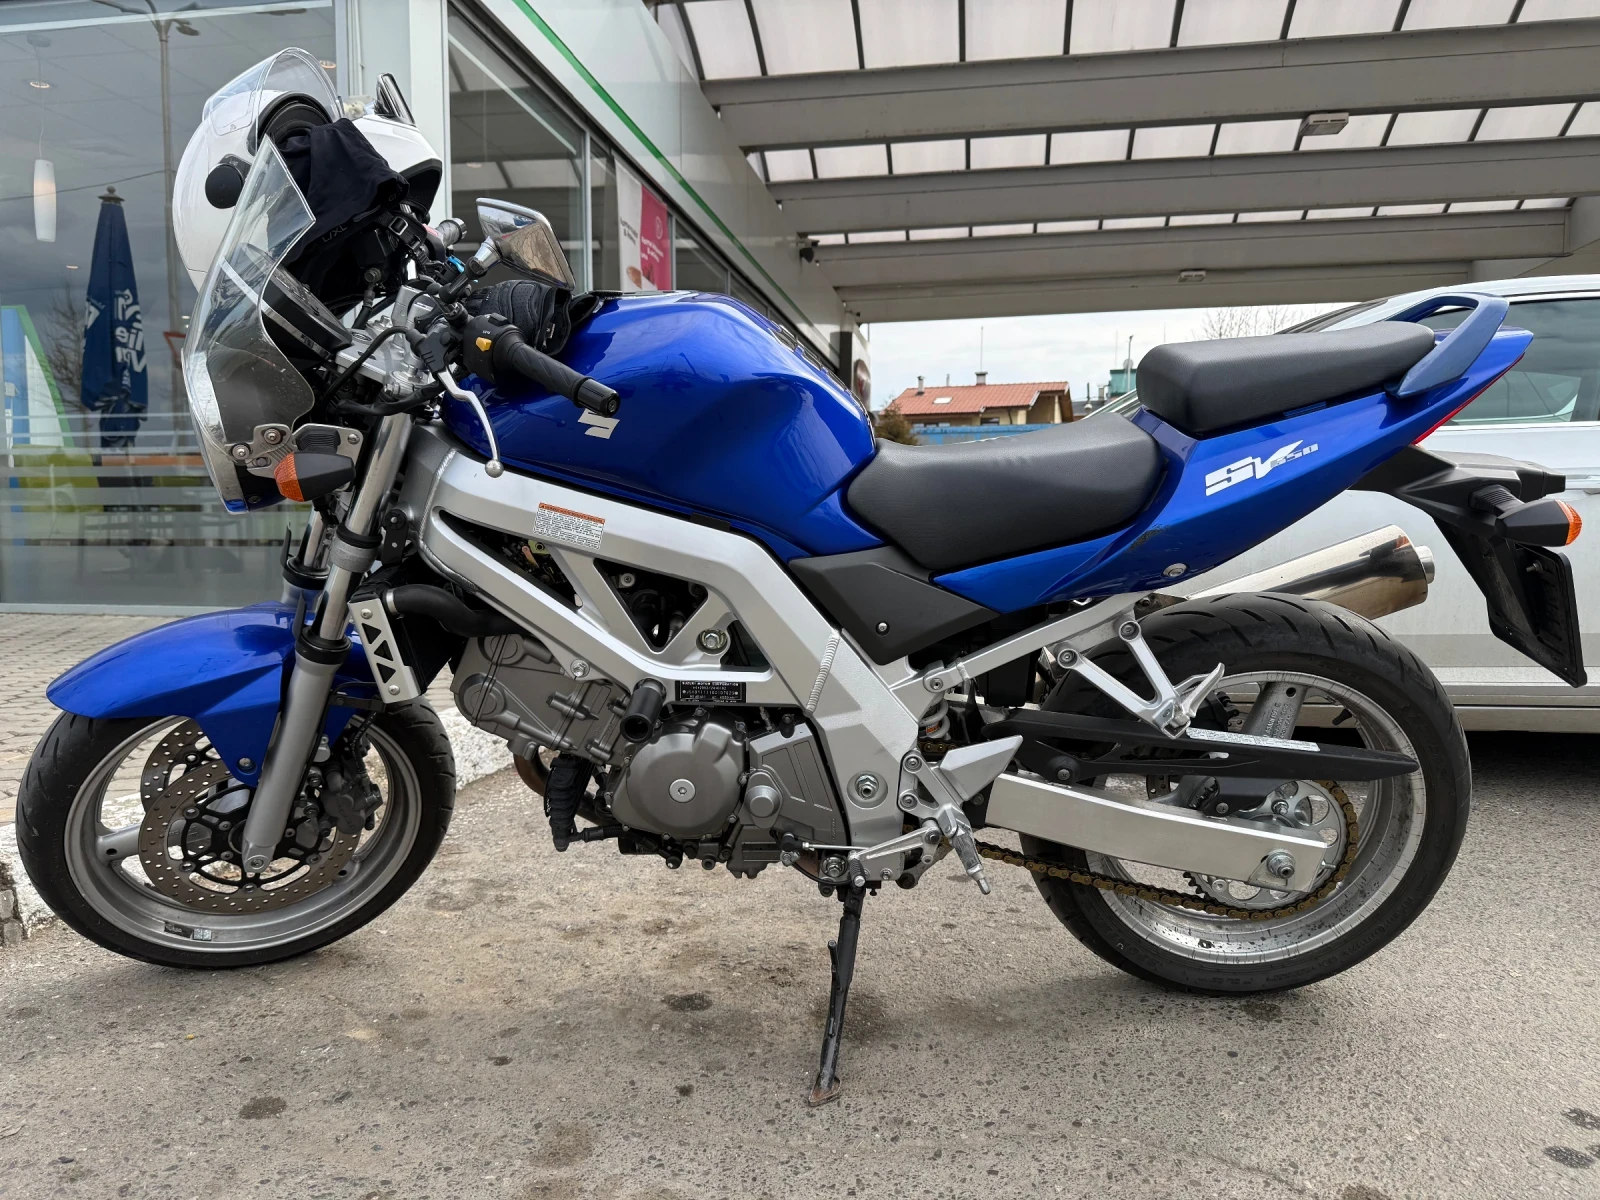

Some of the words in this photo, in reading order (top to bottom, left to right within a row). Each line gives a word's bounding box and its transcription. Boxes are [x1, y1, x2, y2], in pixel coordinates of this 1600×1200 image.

[322, 225, 347, 242] L/XL
[1205, 440, 1303, 496] SV
[1270, 443, 1318, 468] 650
